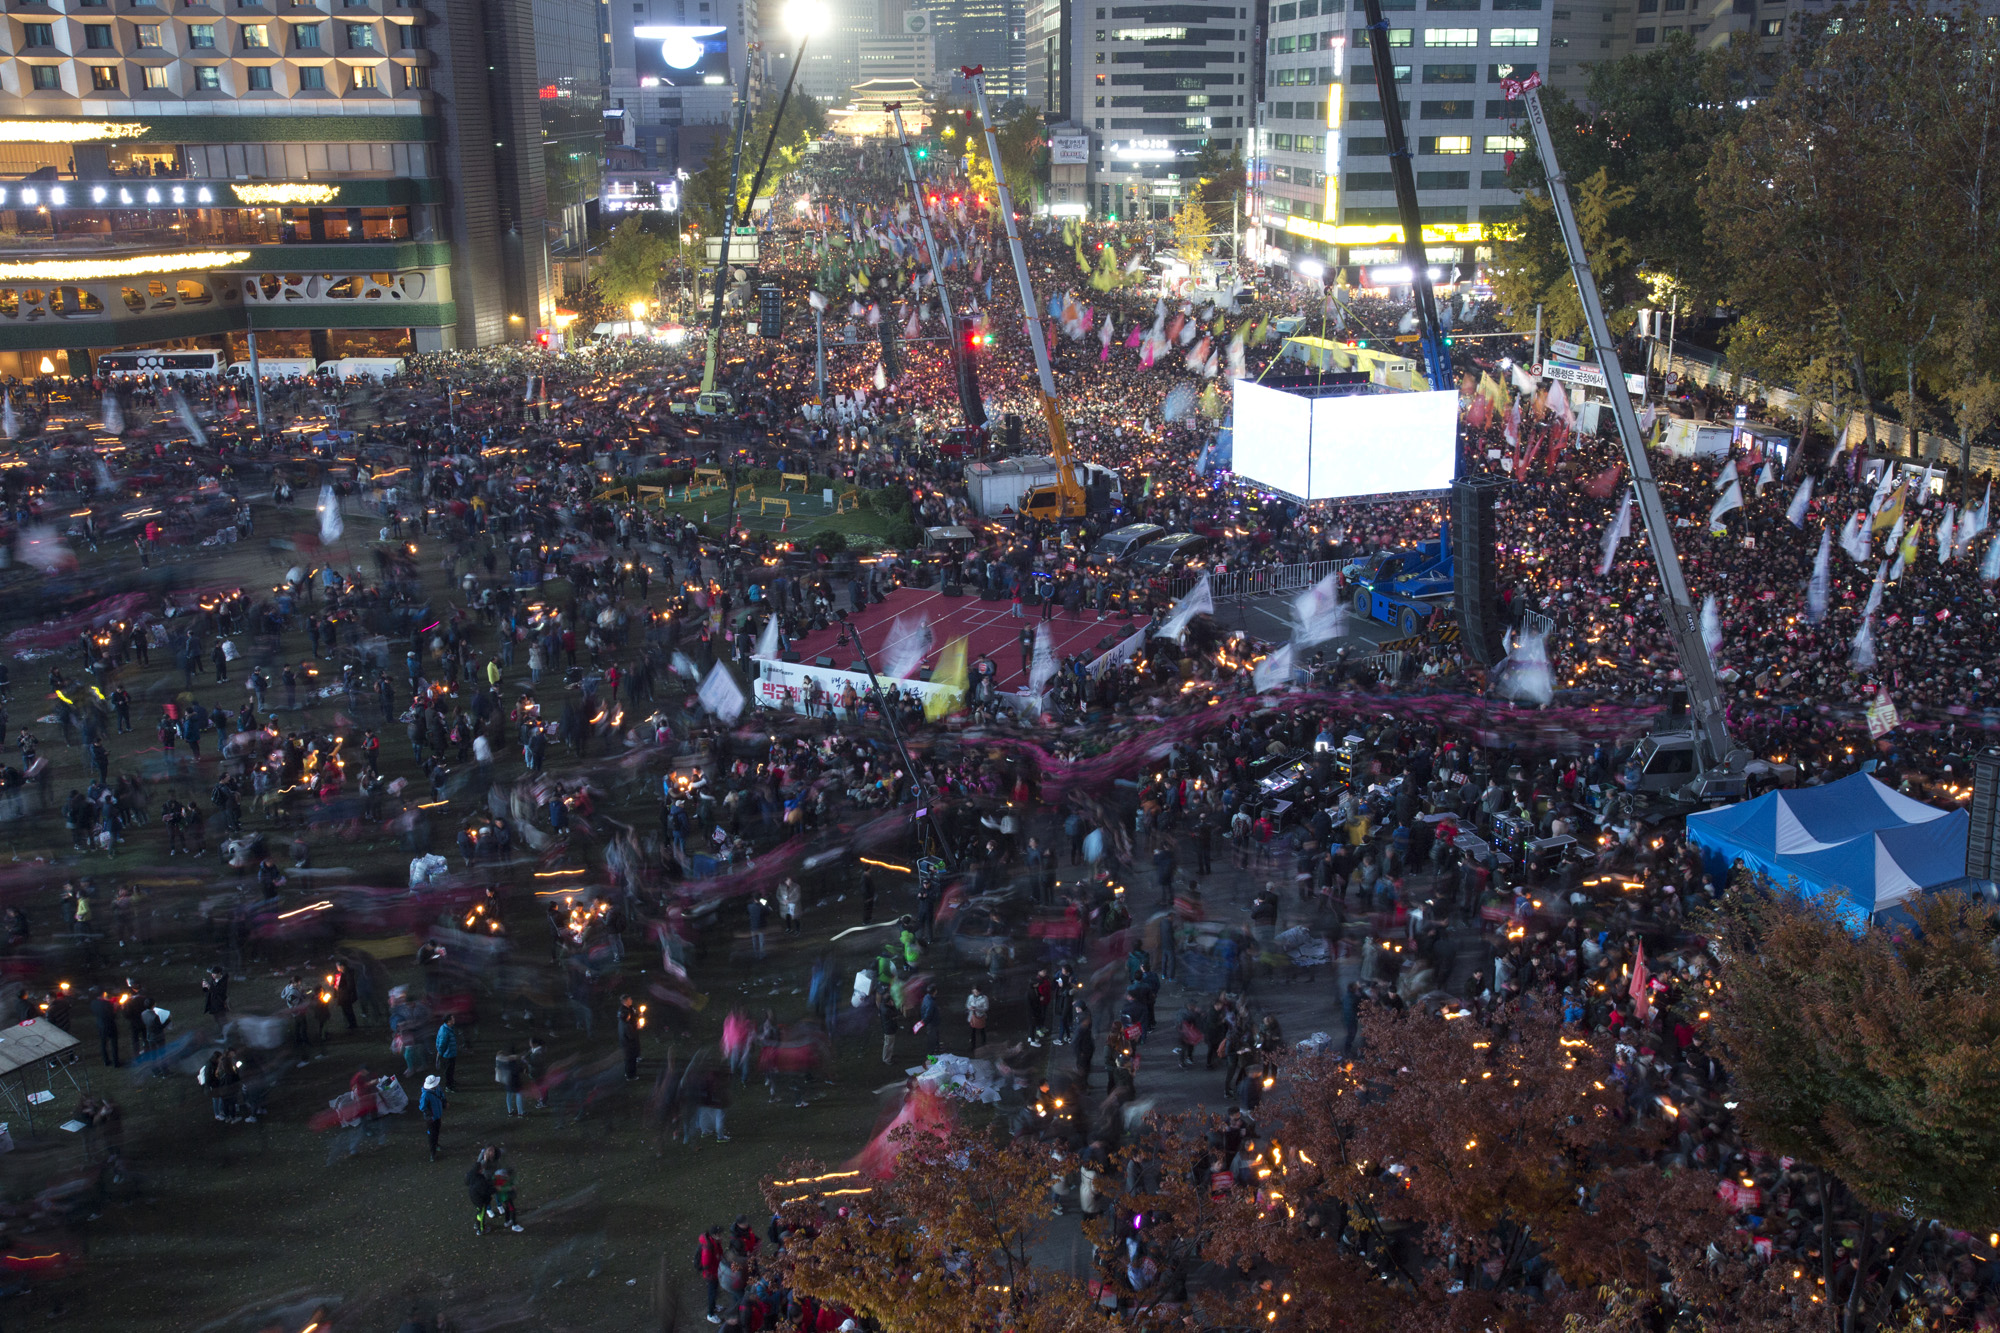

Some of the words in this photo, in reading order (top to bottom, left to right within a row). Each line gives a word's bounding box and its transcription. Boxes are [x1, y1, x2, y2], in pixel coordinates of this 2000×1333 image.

[1530, 96, 1543, 125] KATO
[93, 186, 213, 204] PLAZA
[1547, 366, 1575, 381] 대통령은
[1576, 371, 1604, 386] 국정에서
[1686, 612, 1696, 632] KATO
[762, 682, 802, 703] 박근혜
